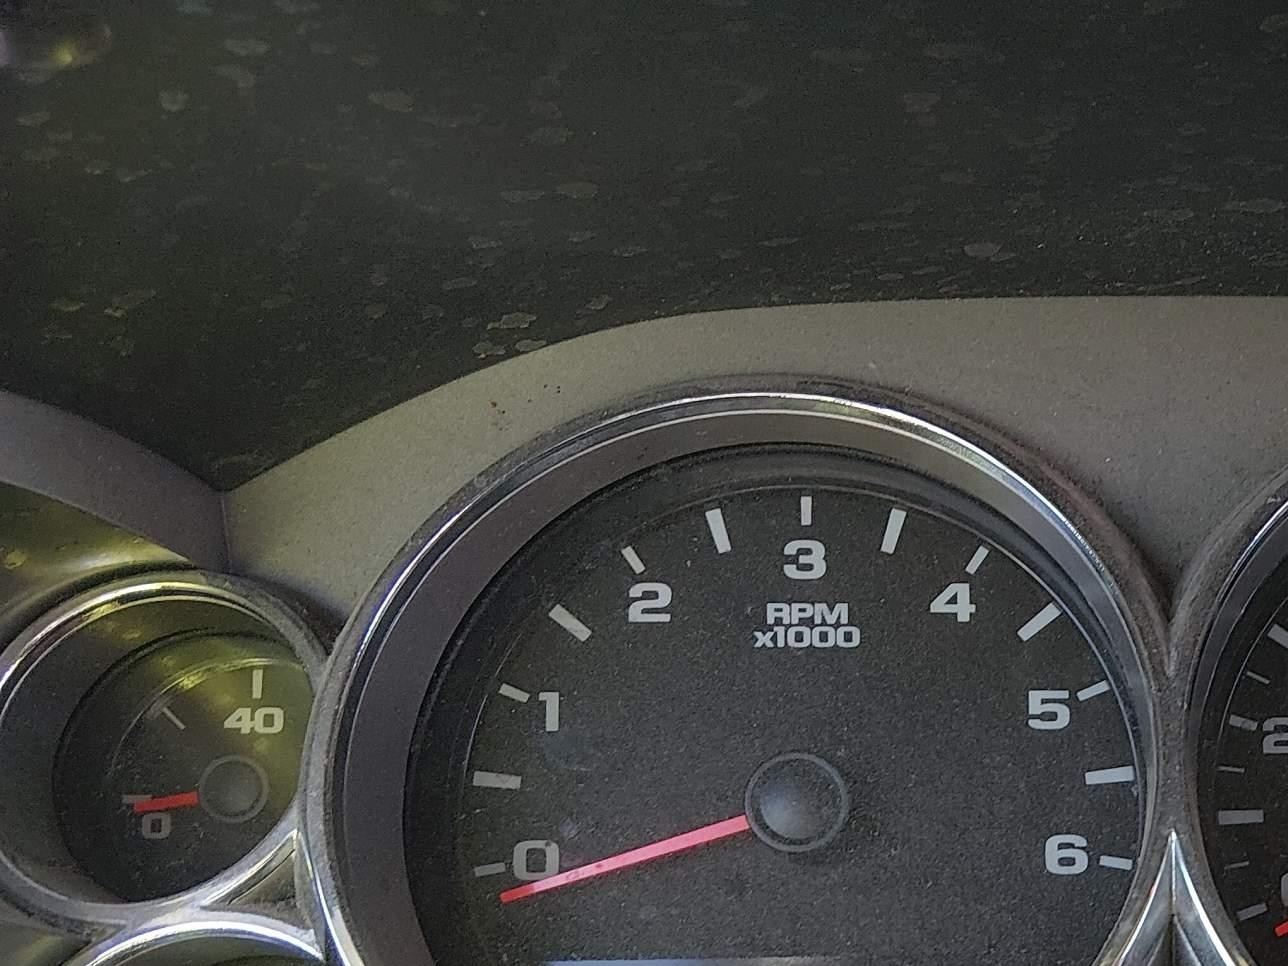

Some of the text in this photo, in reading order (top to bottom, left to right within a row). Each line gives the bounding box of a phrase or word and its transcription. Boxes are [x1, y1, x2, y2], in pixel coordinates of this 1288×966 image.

[782, 539, 828, 580] 3
[628, 582, 672, 623] 2
[766, 602, 849, 626] RPM
[930, 582, 976, 622] 4
[754, 626, 861, 649] x1000
[223, 707, 285, 734] 40
[537, 691, 560, 732] 1
[1027, 689, 1071, 730] 5
[141, 813, 171, 838] 0
[513, 840, 560, 881] 0
[1043, 835, 1089, 875] 6
